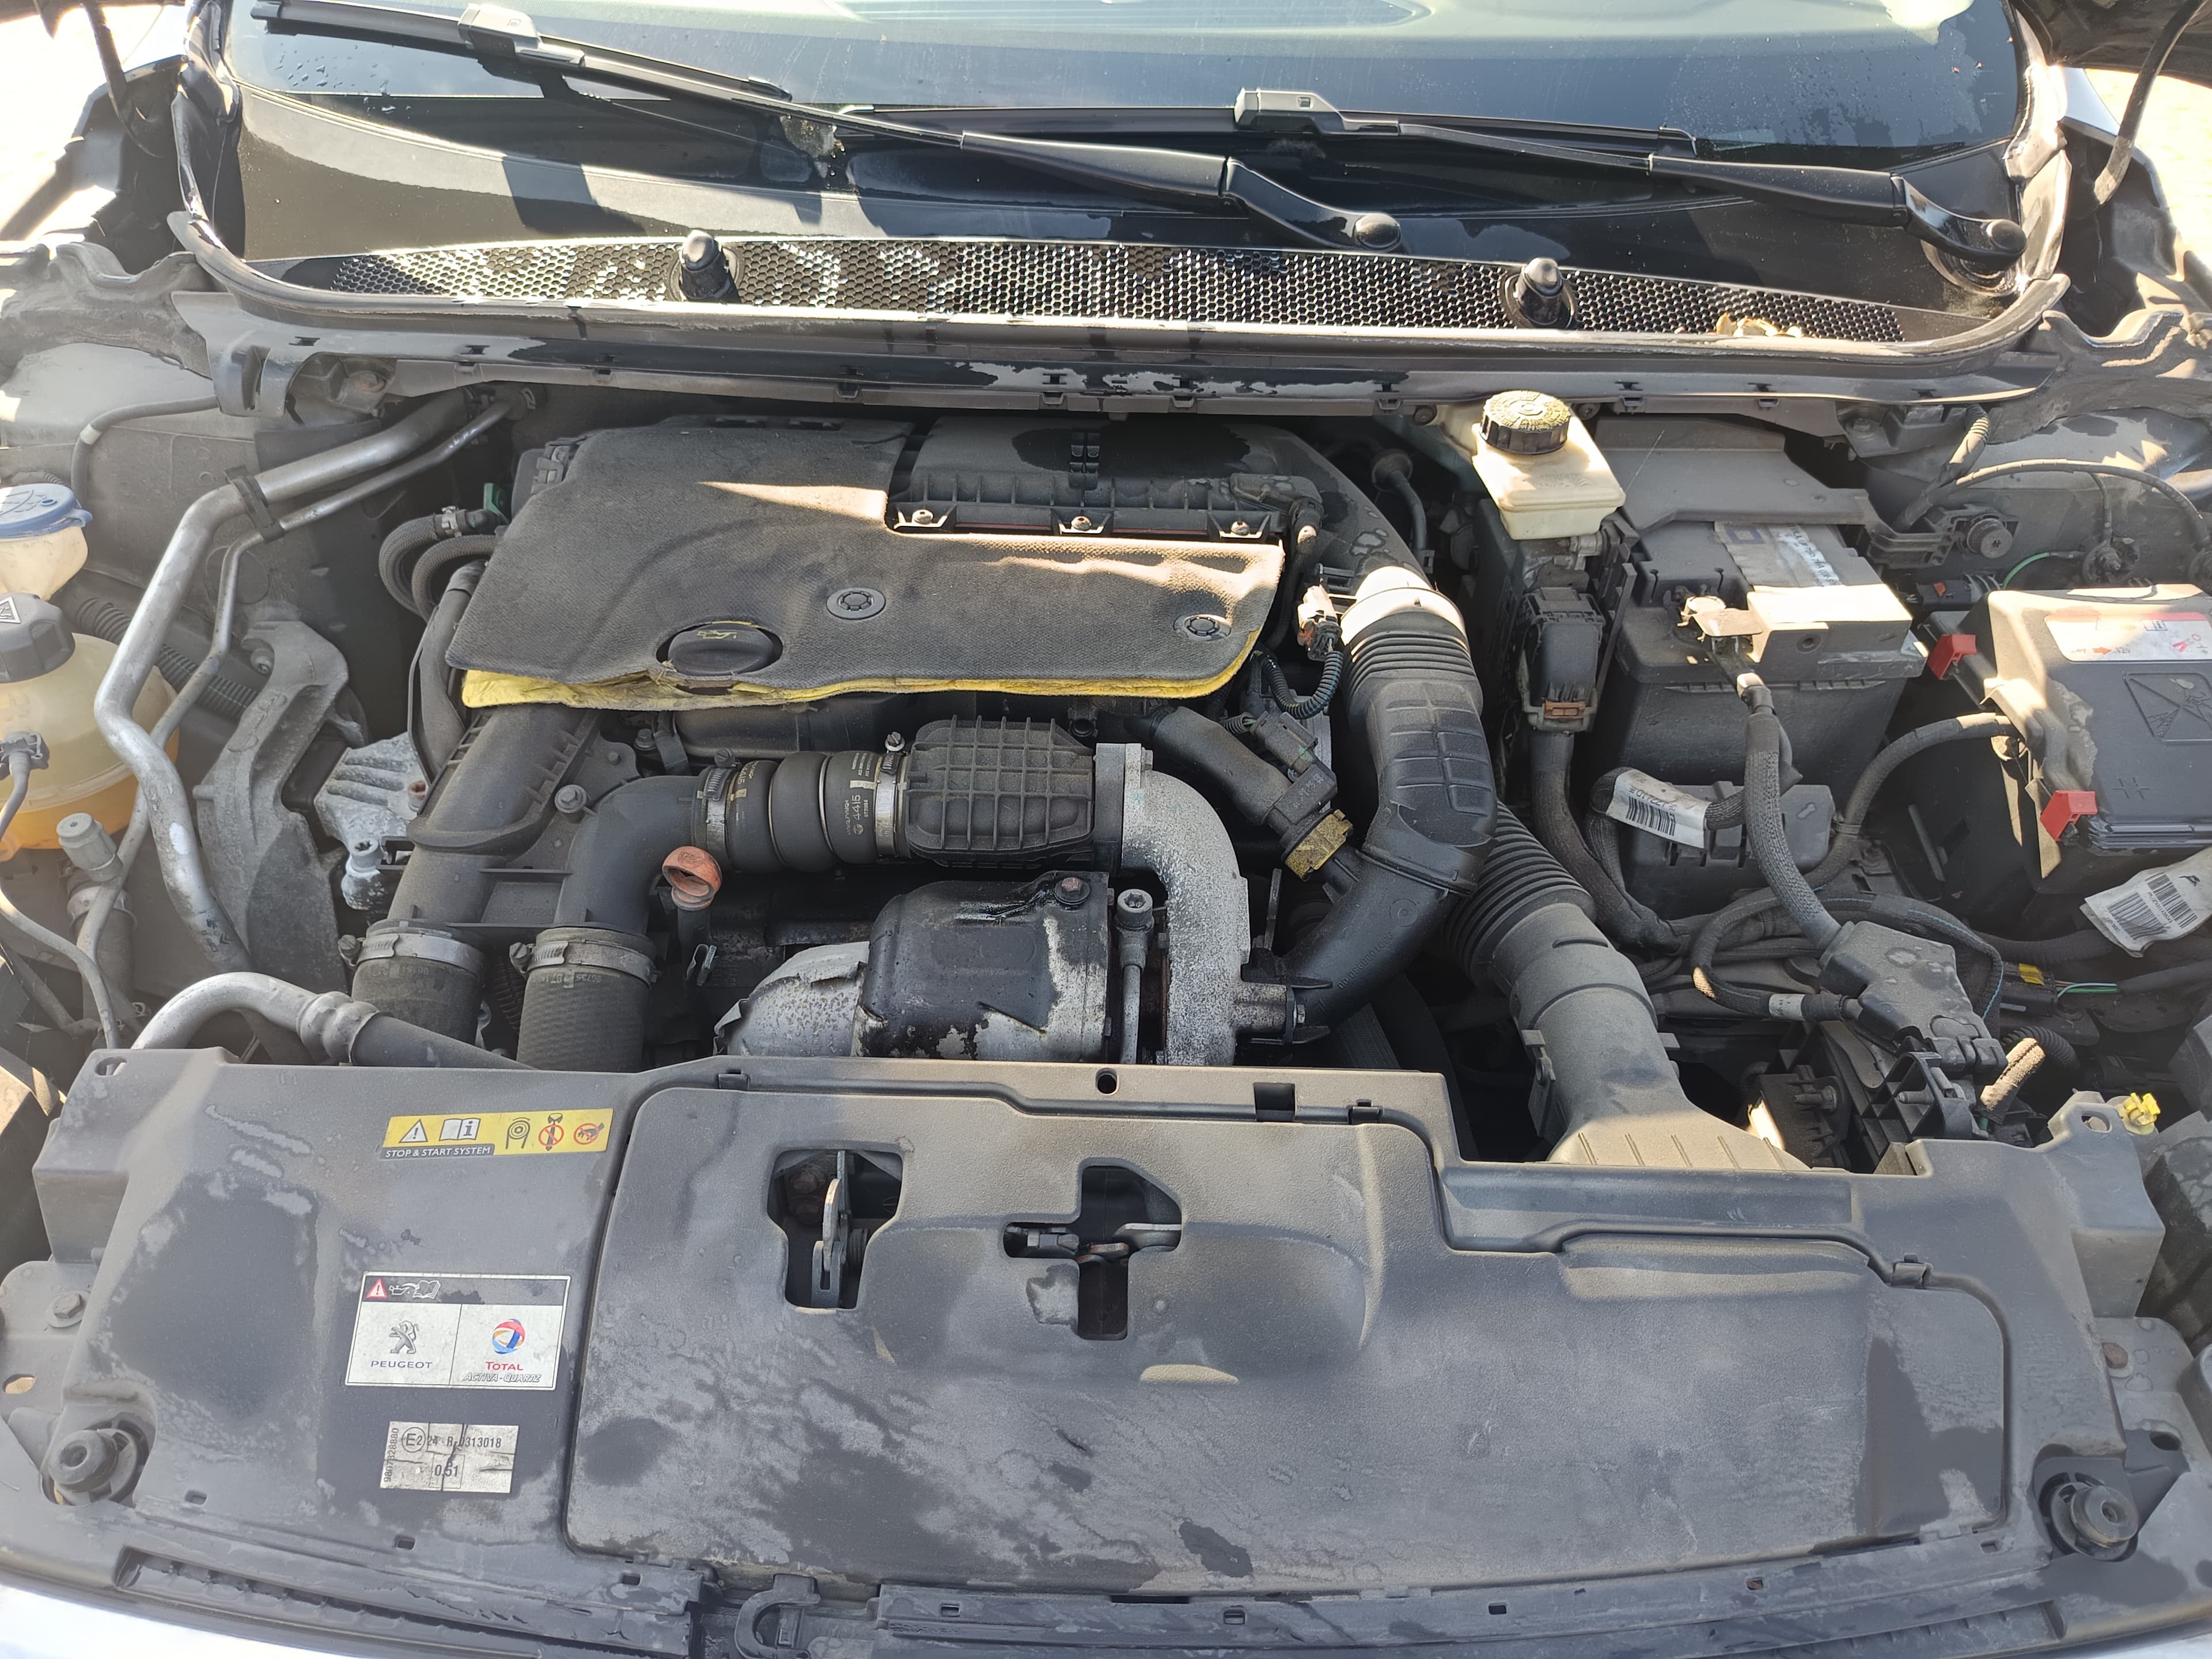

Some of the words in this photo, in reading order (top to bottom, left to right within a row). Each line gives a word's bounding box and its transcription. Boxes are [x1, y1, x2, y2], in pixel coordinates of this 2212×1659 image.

[385, 1149, 411, 1158] STOP
[412, 1149, 419, 1157] &
[421, 1147, 452, 1157] START
[454, 1146, 491, 1156] SYSTEM
[370, 1360, 433, 1369] PEUGEOT
[486, 1361, 524, 1371] TOTAL
